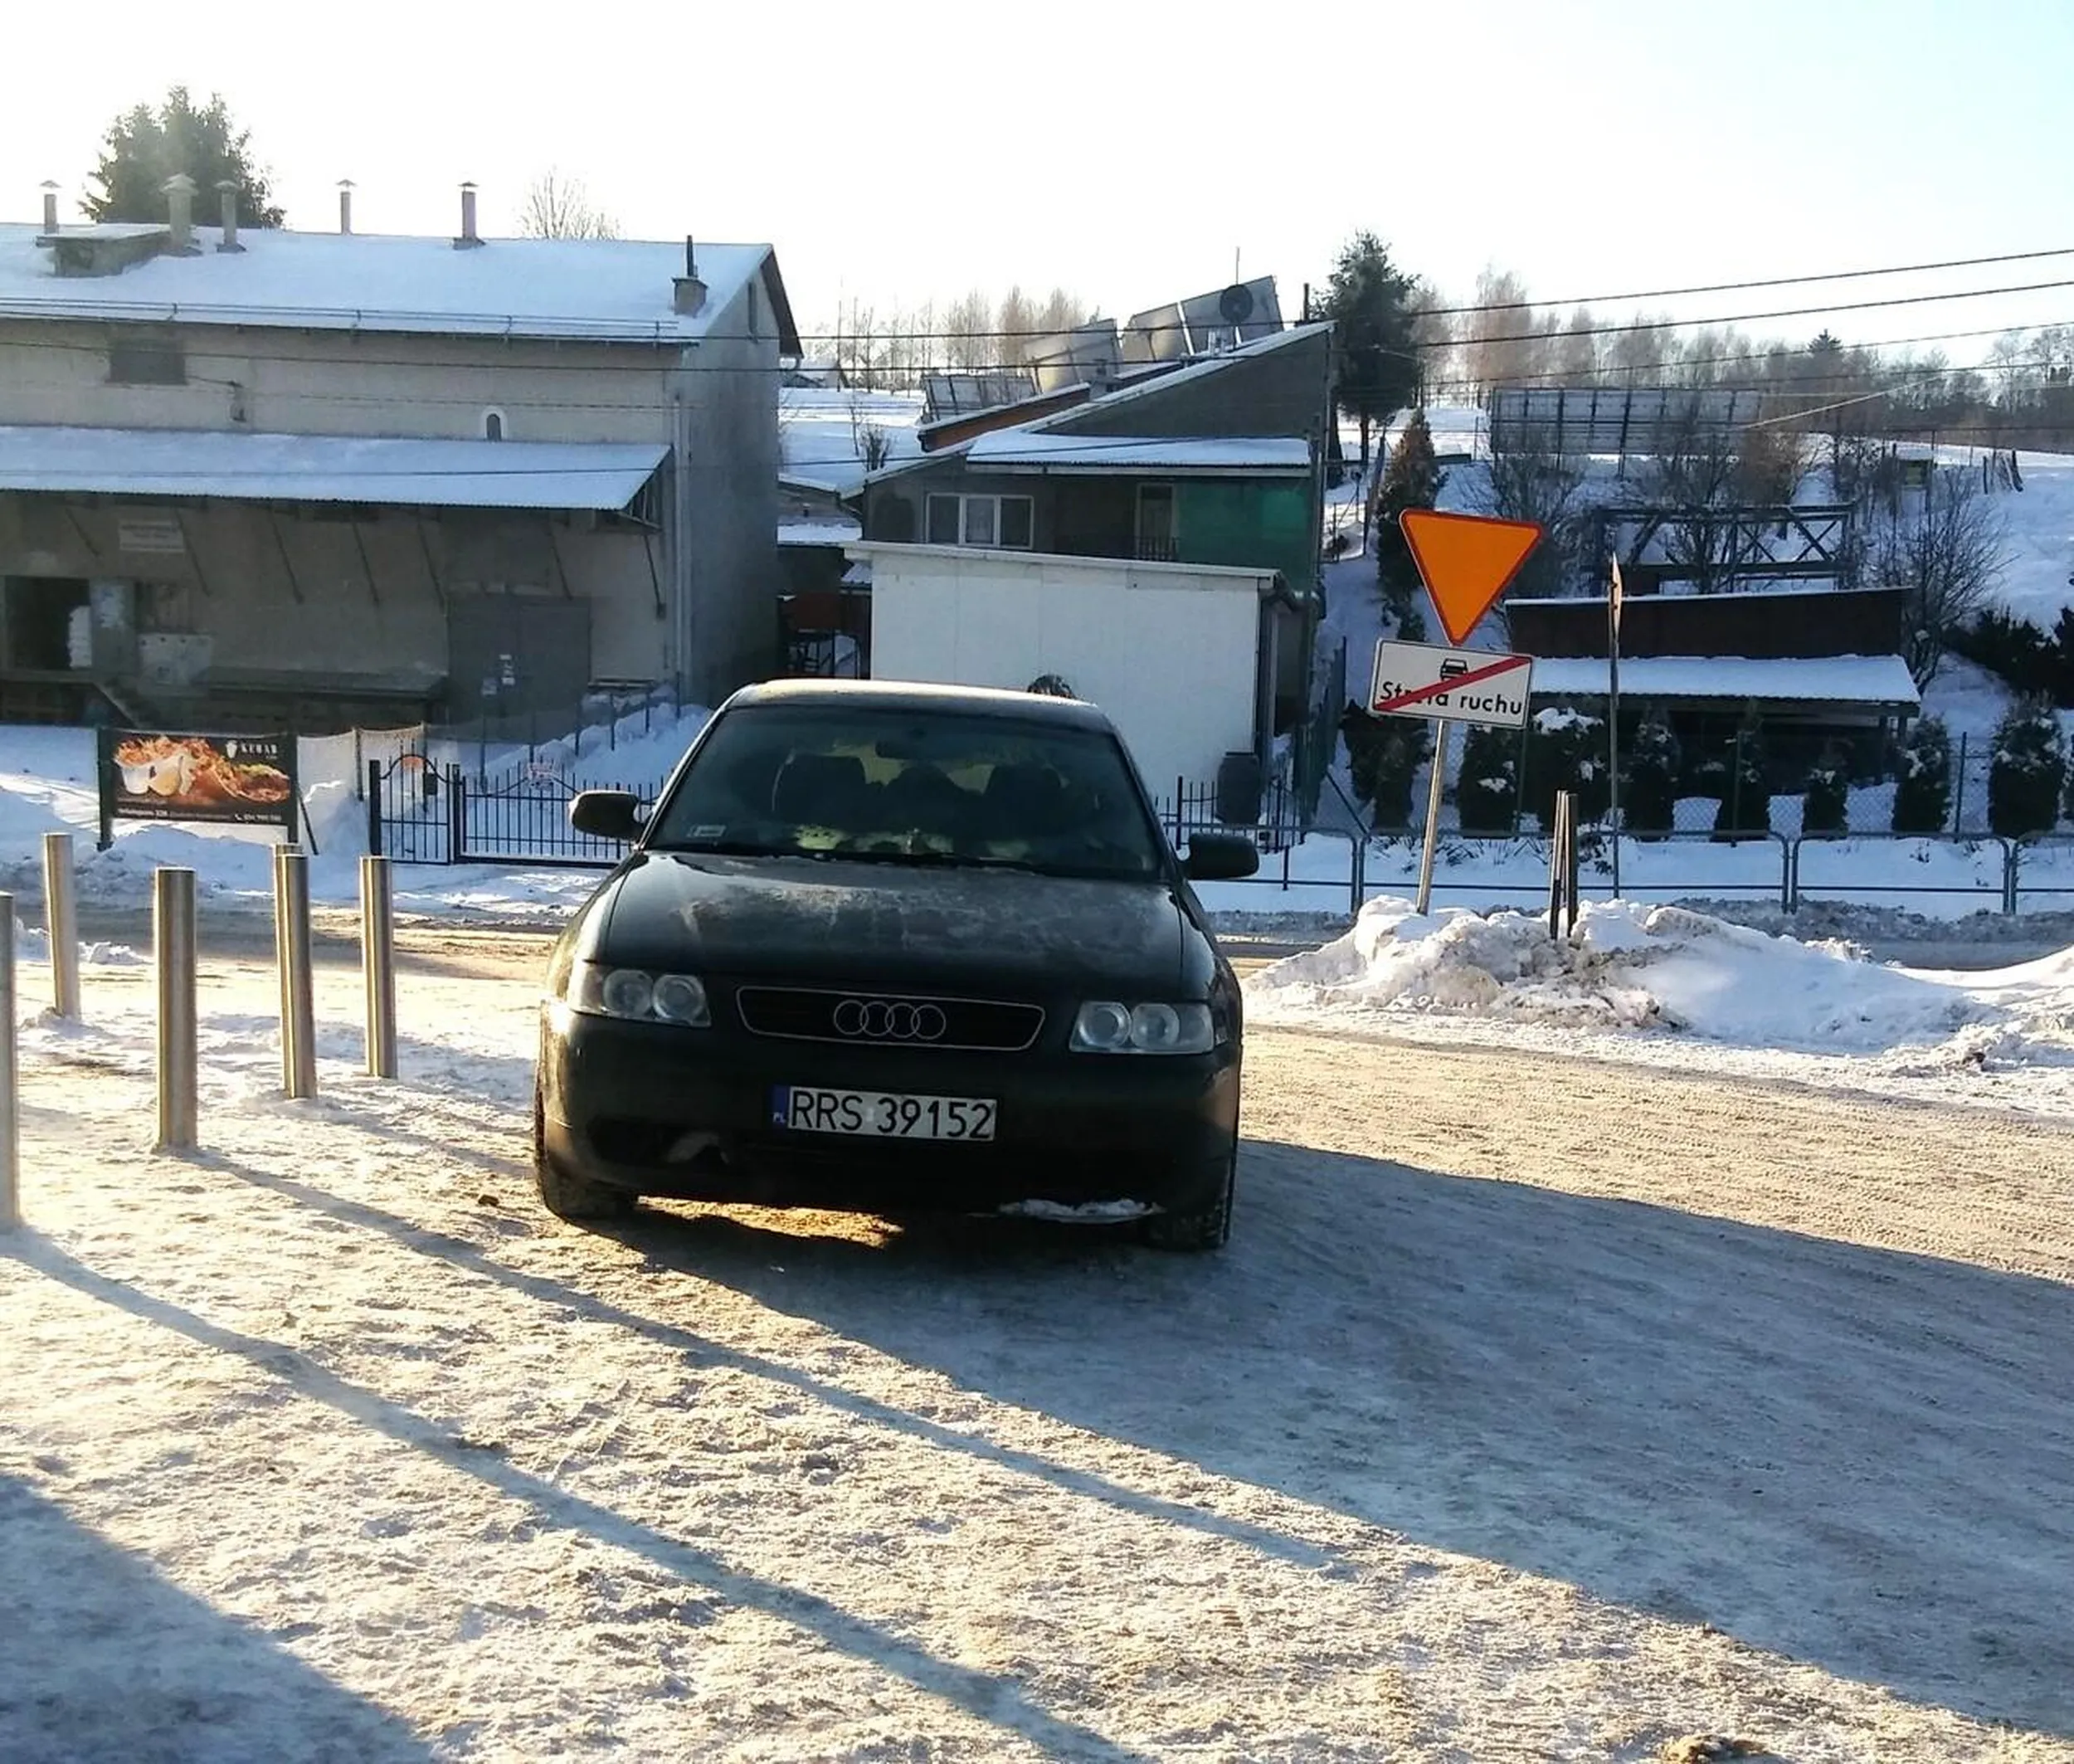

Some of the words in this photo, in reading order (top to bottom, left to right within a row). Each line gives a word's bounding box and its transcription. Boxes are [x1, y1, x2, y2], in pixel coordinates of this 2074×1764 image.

[1380, 681, 1448, 706] Stra
[1460, 694, 1521, 715] ruchu
[791, 1089, 864, 1131] RRS
[877, 1097, 993, 1139] 39152
